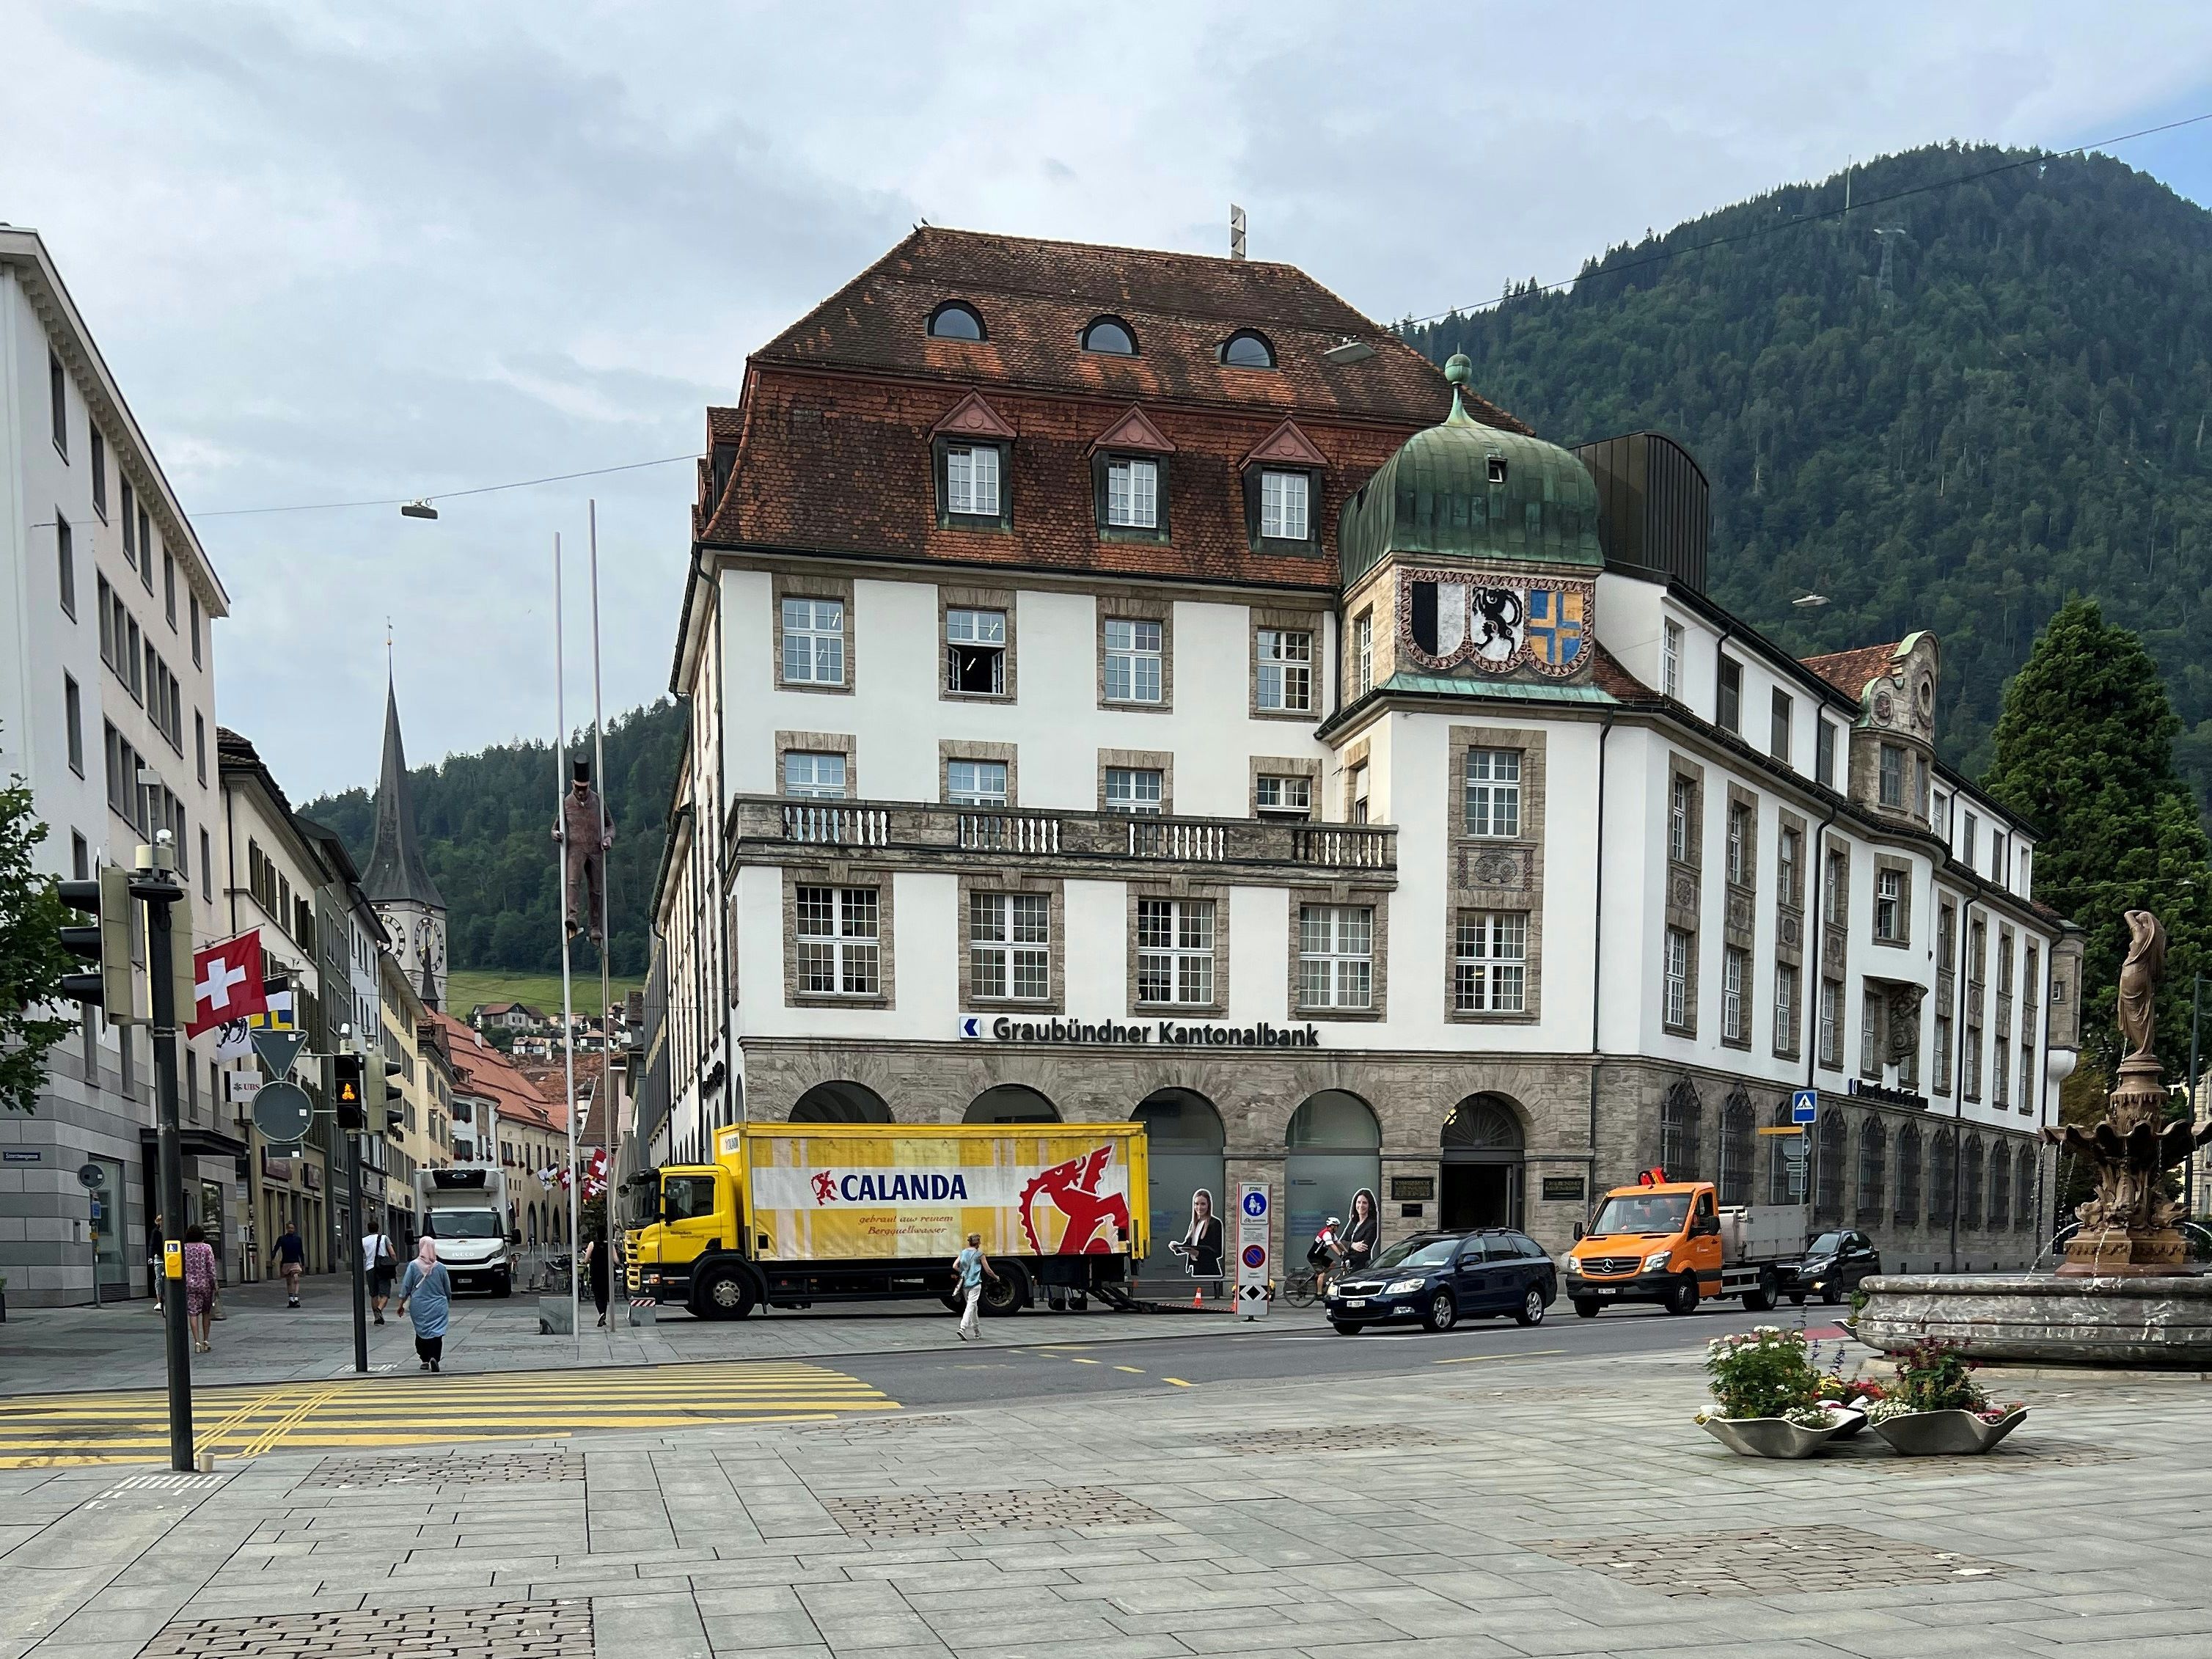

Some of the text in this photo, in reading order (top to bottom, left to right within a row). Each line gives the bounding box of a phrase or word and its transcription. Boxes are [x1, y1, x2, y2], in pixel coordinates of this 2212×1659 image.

[993, 1017, 1319, 1046] Graubündner Kantonalbank
[841, 1174, 968, 1201] CALANDA
[858, 1215, 897, 1225] gebraut
[868, 1226, 948, 1236] Bergquellwasser
